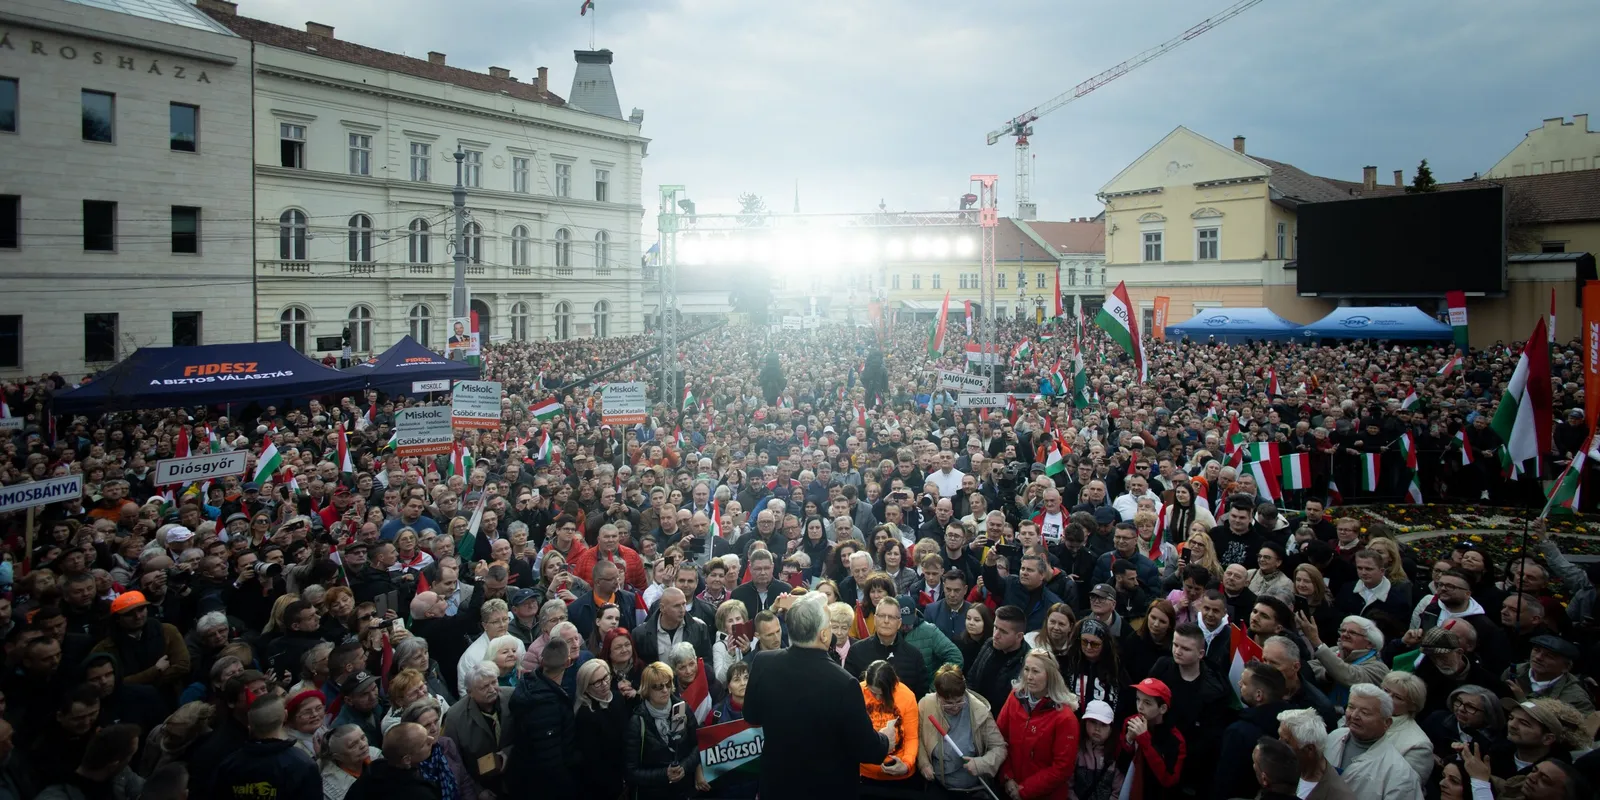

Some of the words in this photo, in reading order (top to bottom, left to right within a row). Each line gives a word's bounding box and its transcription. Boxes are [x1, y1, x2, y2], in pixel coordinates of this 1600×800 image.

[184, 362, 258, 377] FIDESZ
[163, 376, 216, 385] BIZTOS
[217, 370, 294, 381] VÁLASZTÁS
[944, 373, 984, 387] SAJÓVÁMOS
[420, 382, 442, 390] MISKOLC
[461, 384, 493, 394] Miskolc
[968, 396, 997, 405] MISKOLC
[405, 410, 443, 420] Miskolc
[397, 438, 425, 446] Csöbör
[169, 457, 235, 476] Diósgyőr
[705, 735, 764, 766] Alsózsol
